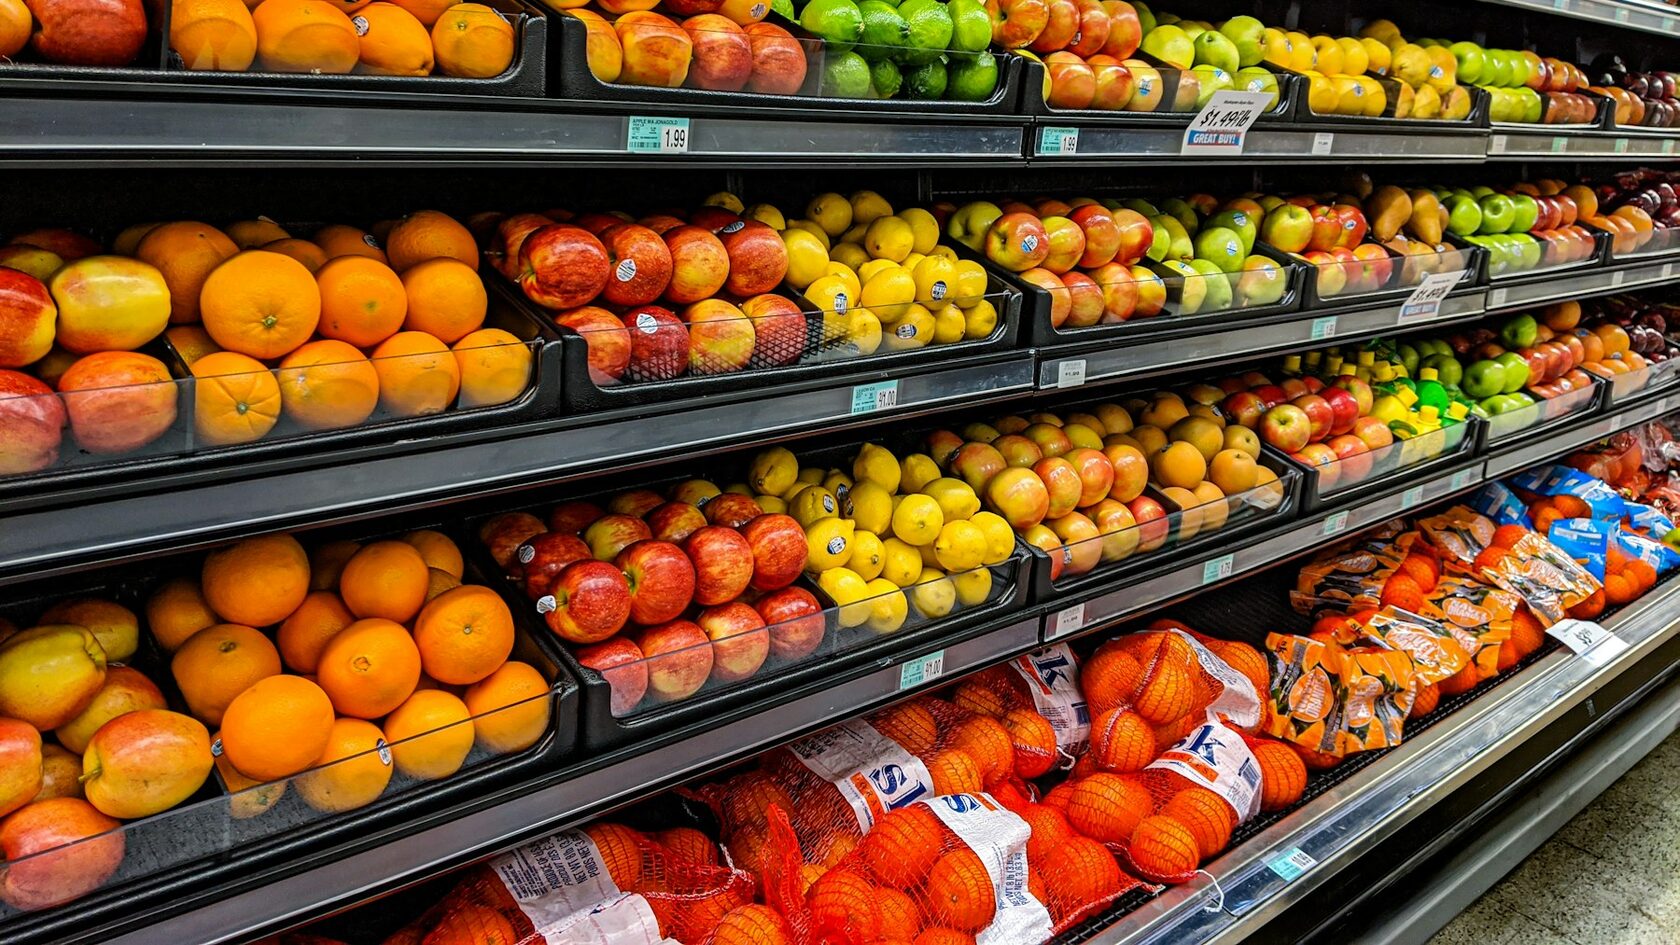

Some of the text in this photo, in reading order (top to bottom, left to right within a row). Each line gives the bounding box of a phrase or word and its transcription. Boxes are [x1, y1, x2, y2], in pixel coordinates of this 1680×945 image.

[1200, 109, 1239, 127] $1.49
[665, 129, 686, 148] 1.99
[1063, 136, 1076, 151] 1.99
[1193, 133, 1236, 144] GREAT BUY!
[1032, 651, 1070, 689] k
[1171, 725, 1226, 767] k
[548, 849, 561, 862] DES
[577, 844, 591, 859] NET
[536, 856, 549, 865] OF
[568, 858, 582, 872] WT
[583, 857, 600, 878] POIDS
[554, 861, 574, 886] PRODUIT
[1015, 861, 1024, 876] 3.63
[540, 863, 563, 890] PRODUCE
[573, 870, 588, 883] NET
[1006, 887, 1013, 897] WT
